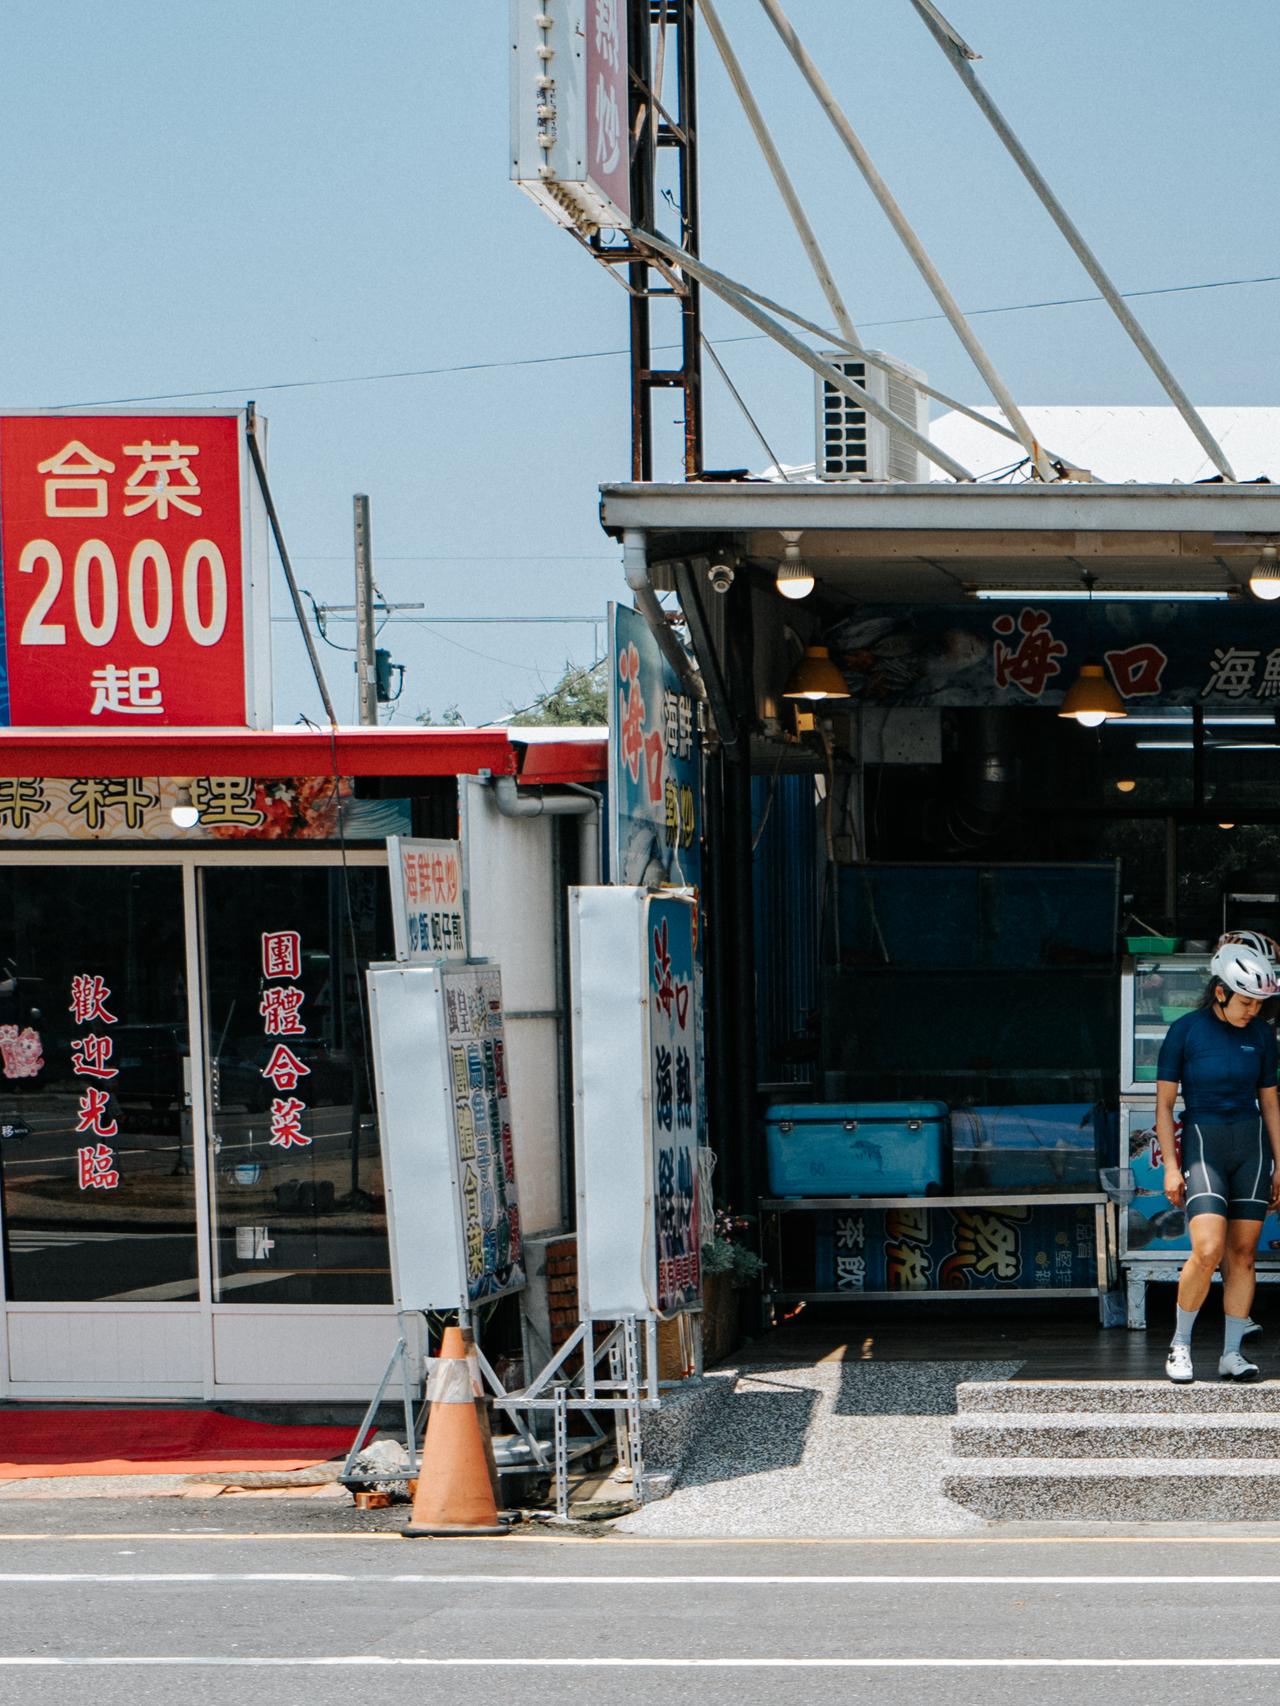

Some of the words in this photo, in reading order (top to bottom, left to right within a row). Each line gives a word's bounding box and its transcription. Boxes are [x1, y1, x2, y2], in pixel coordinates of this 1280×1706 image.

[37, 440, 202, 520] 合菜
[18, 539, 228, 646] 2000
[90, 664, 164, 715] 起
[994, 607, 1167, 698] 海口
[404, 853, 459, 904] 海鮮快炒
[68, 974, 120, 1190] 歡迎光臨
[260, 931, 312, 1149] 團體合菜
